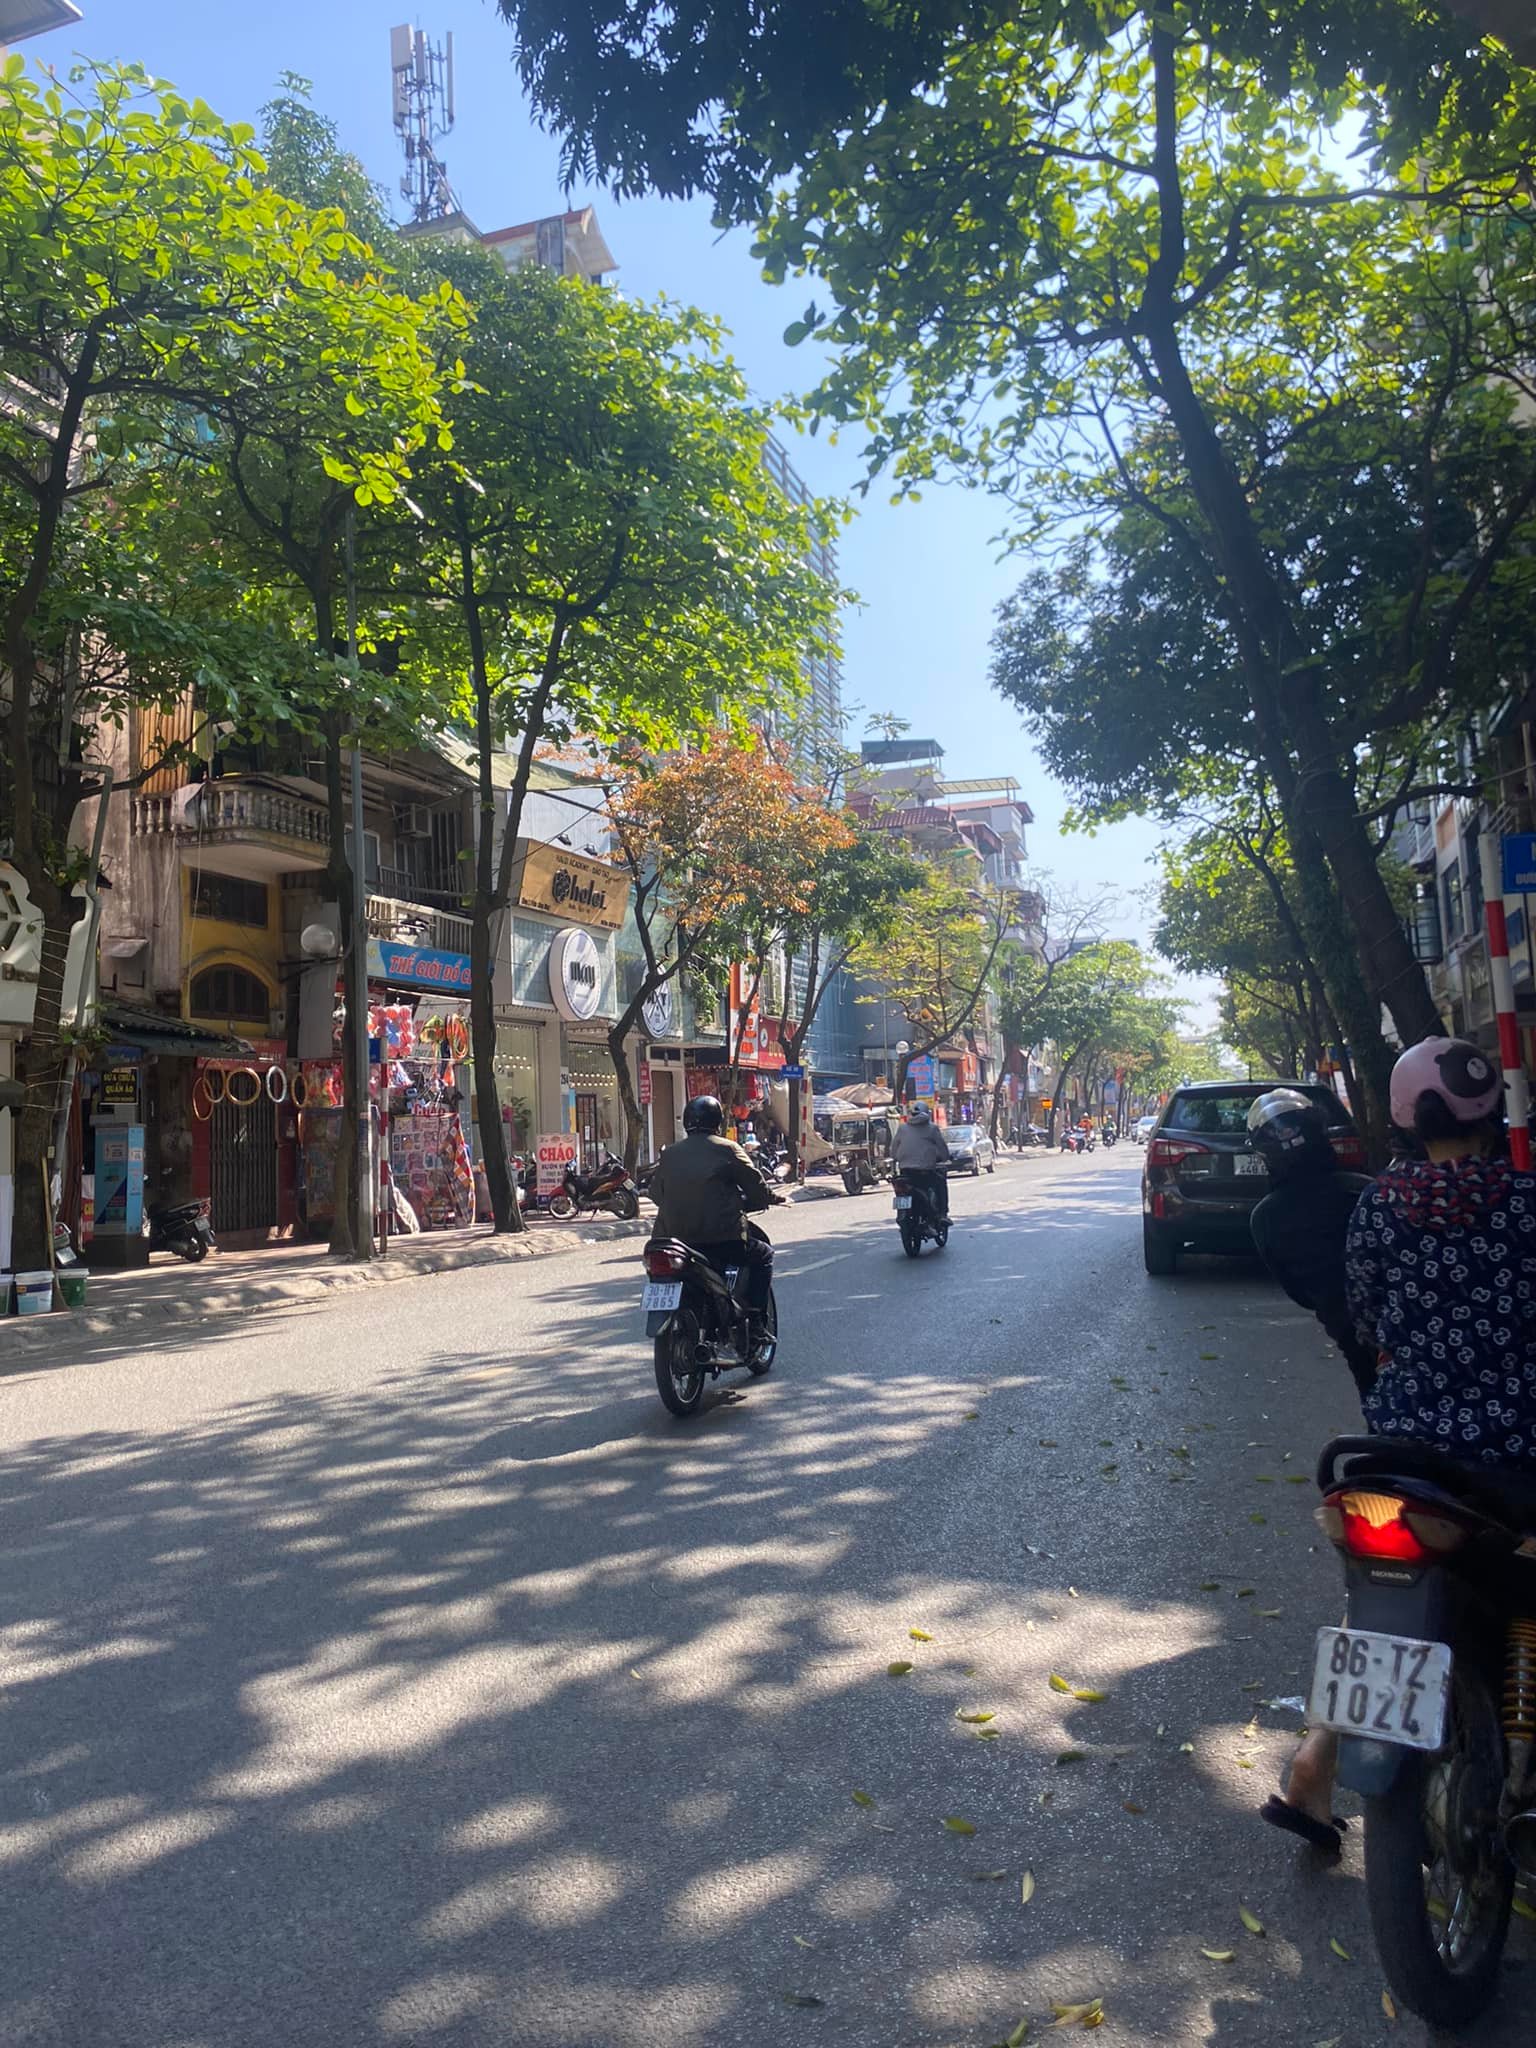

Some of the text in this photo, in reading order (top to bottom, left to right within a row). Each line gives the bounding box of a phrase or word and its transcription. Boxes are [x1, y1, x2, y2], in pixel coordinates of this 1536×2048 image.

[389, 952, 417, 975] THẾ
[416, 959, 442, 979] GIỚI
[539, 1143, 574, 1162] CHÁO
[1371, 1570, 1412, 1580] HONDA
[1330, 1632, 1431, 1690] 86-T2
